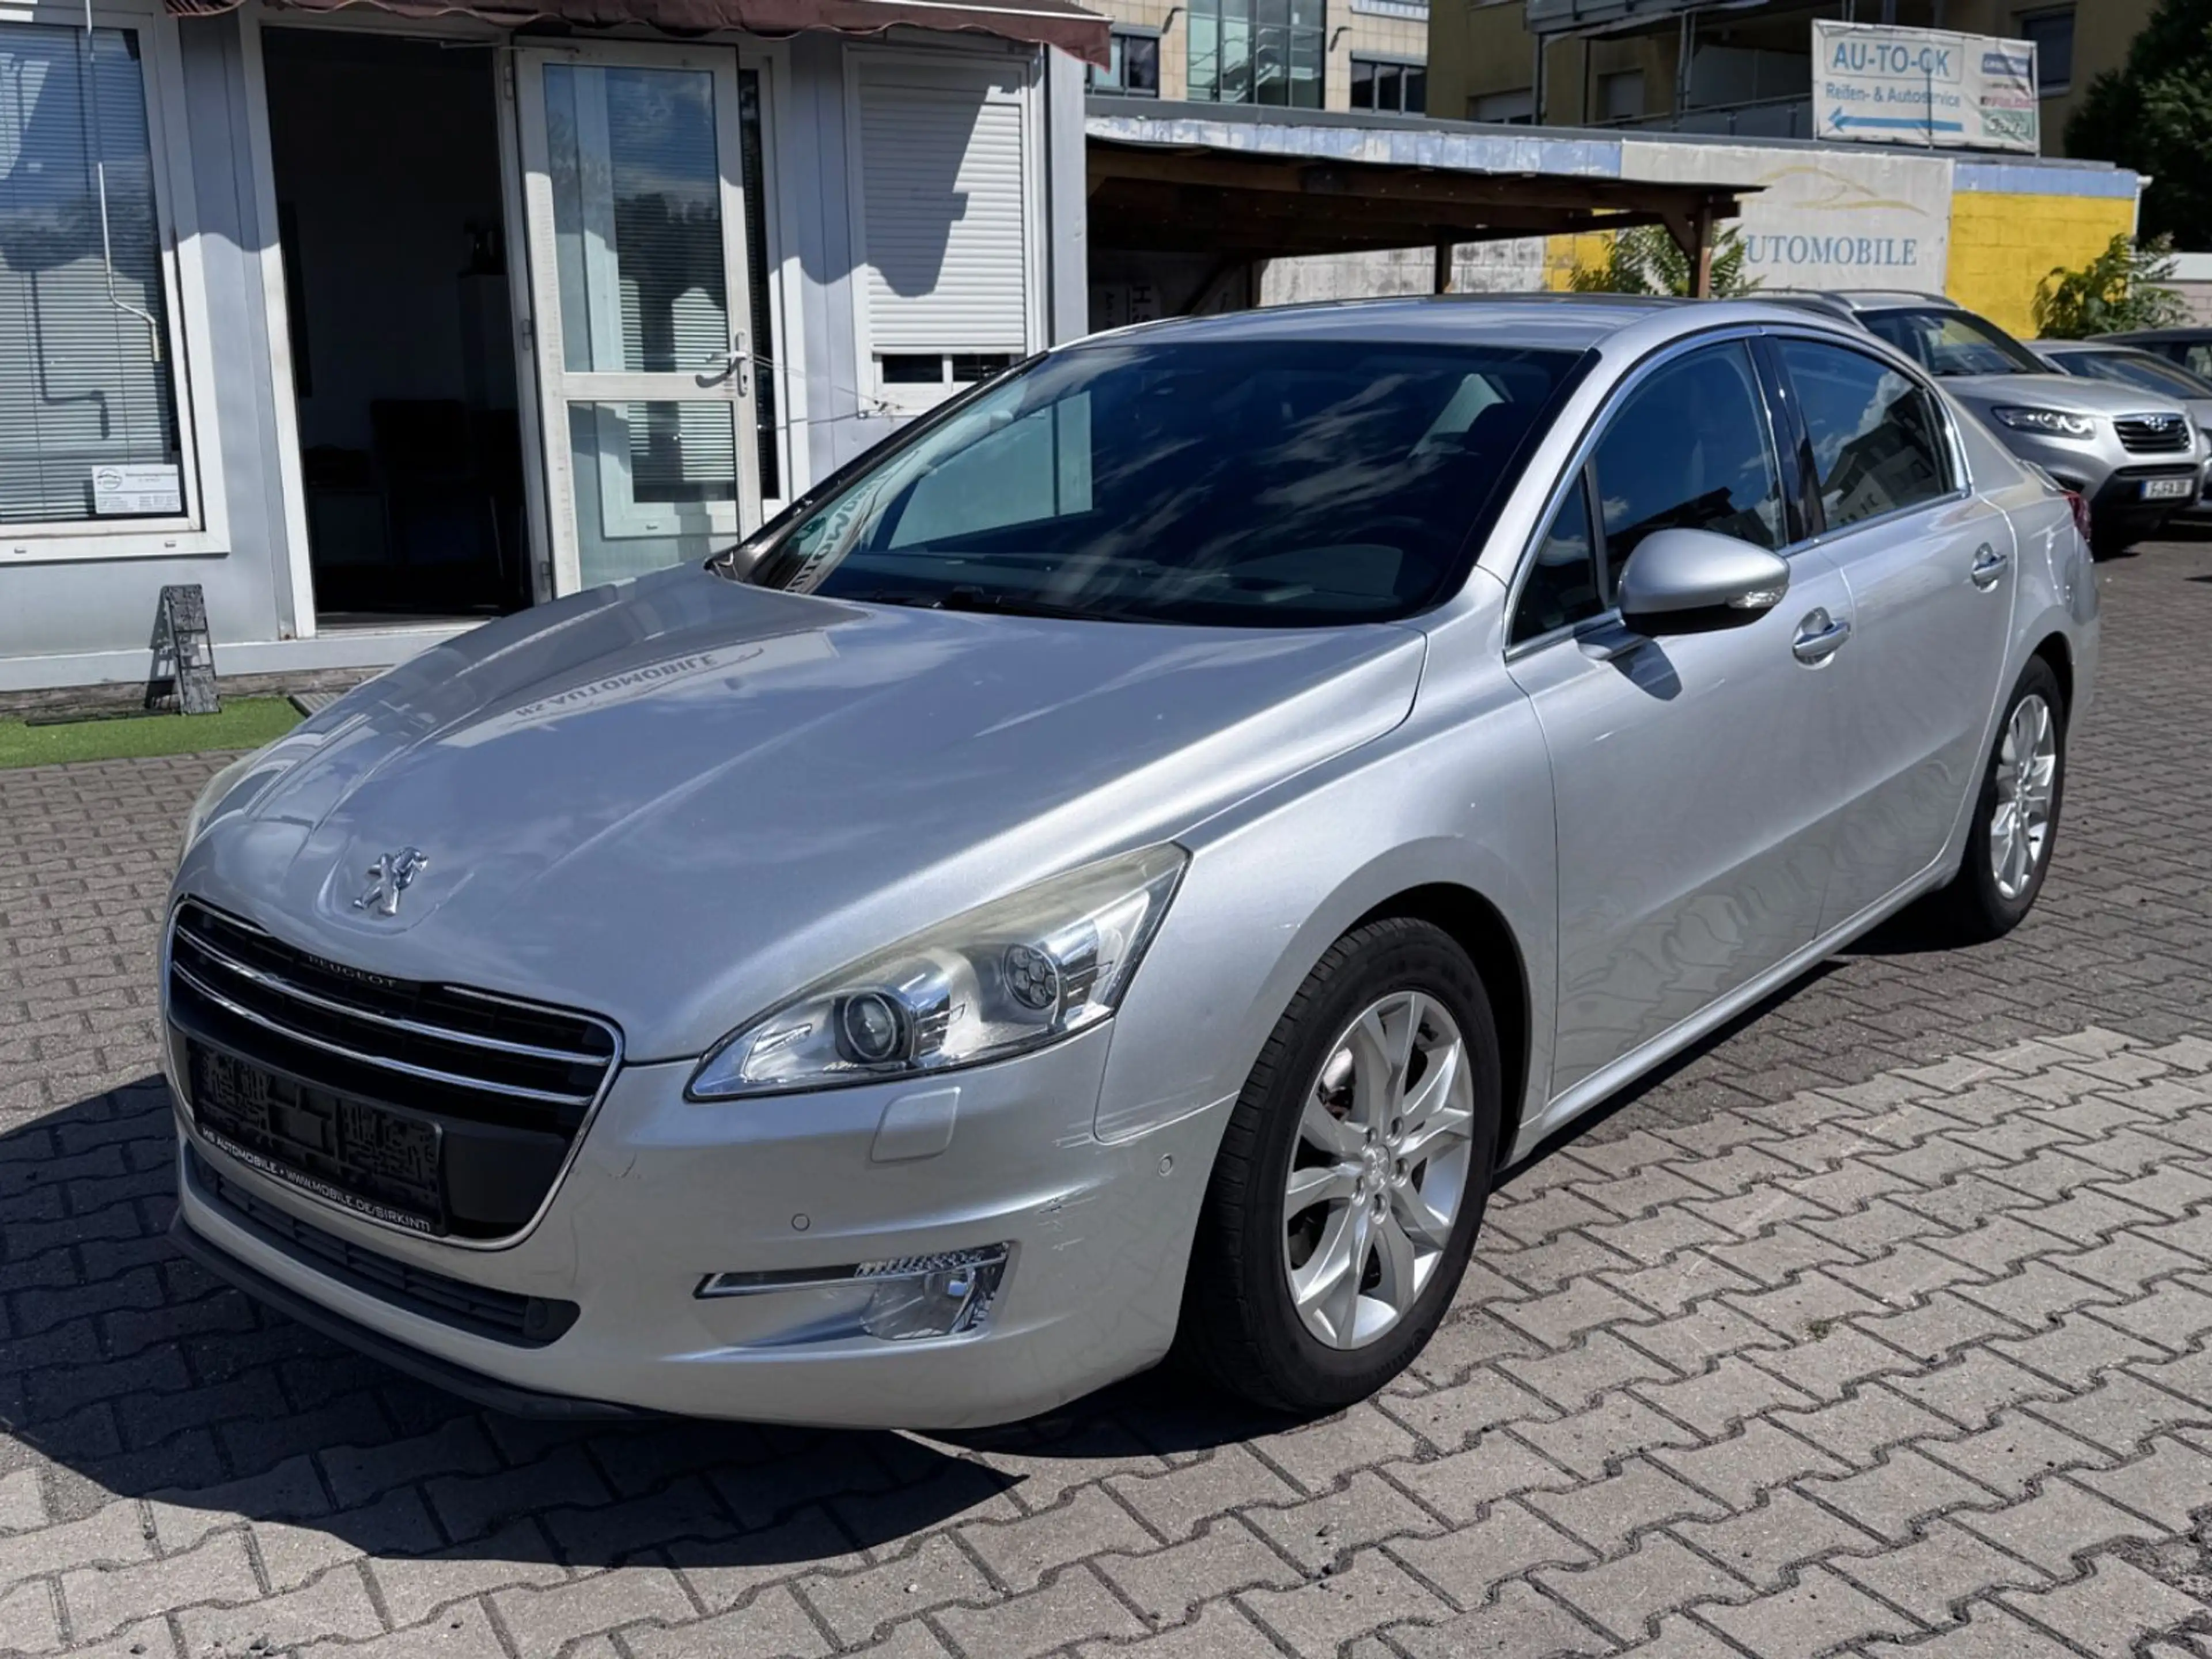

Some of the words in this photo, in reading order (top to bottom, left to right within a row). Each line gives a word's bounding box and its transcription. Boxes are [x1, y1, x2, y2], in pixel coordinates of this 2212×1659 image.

[1874, 86, 1883, 103] &
[1747, 235, 1917, 266] UTOMOBILE
[309, 955, 396, 987] PEUGEOT
